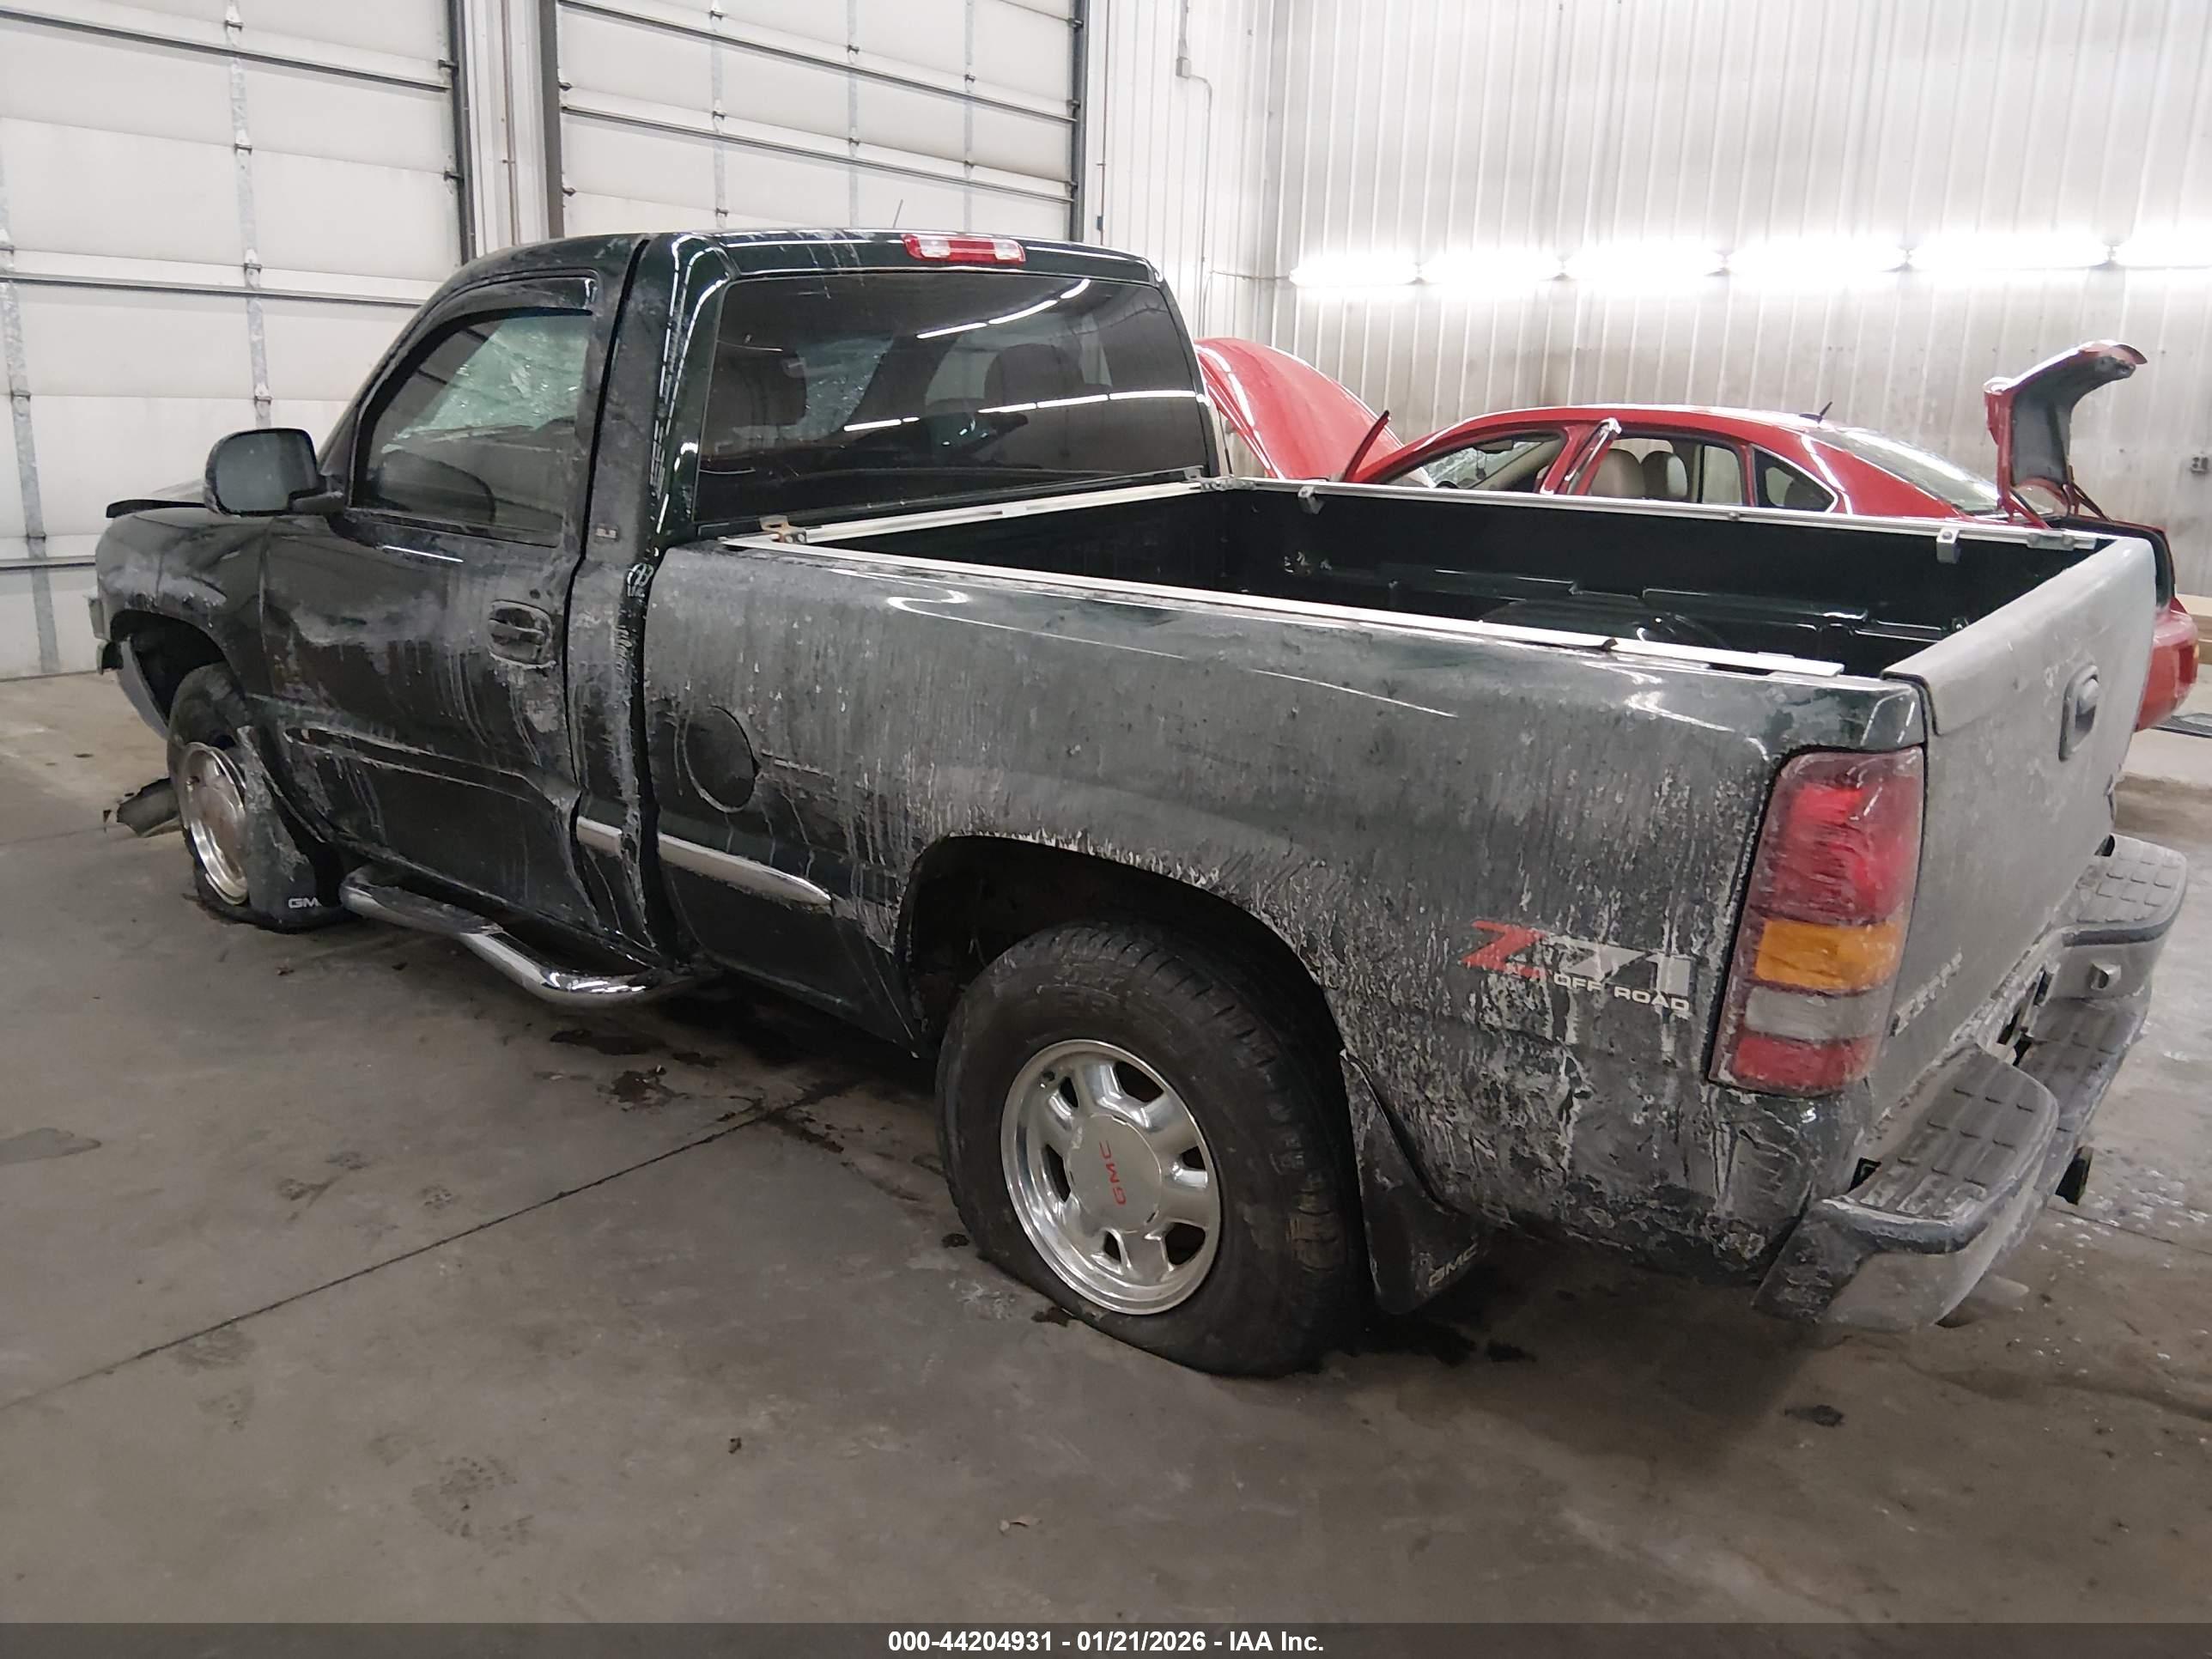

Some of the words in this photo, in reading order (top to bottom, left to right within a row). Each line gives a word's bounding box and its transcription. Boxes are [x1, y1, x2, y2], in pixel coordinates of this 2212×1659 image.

[288, 896, 323, 909] GM
[1459, 919, 1692, 998] Z71
[1553, 971, 1603, 993] OFF
[1613, 985, 1691, 1012] ROAD
[1098, 1139, 1127, 1206] GMC
[1428, 1242, 1479, 1288] GMC
